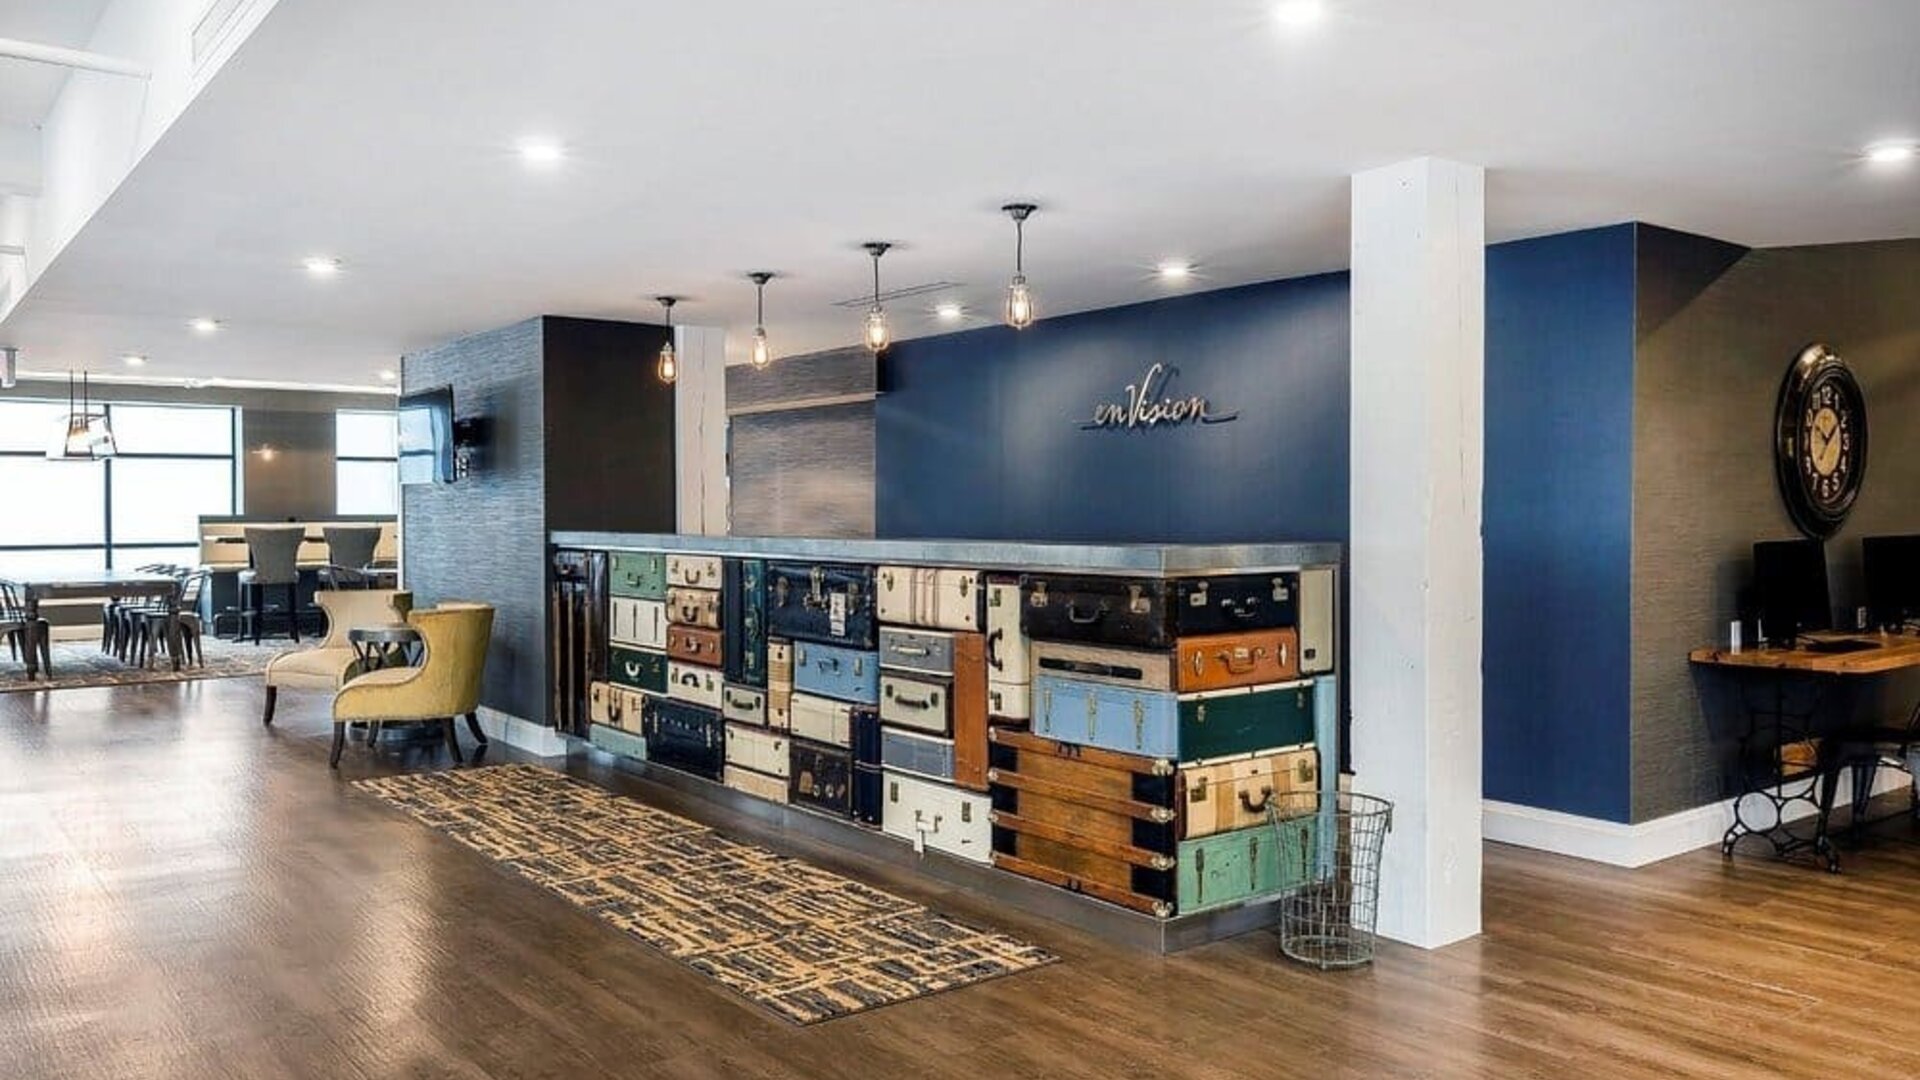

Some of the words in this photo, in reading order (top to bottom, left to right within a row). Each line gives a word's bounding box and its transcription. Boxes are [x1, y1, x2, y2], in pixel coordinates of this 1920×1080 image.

[1078, 362, 1239, 428] enVision
[1821, 385, 1832, 405] 12
[1840, 410, 1847, 428] 2
[1842, 433, 1849, 451] 3
[1840, 455, 1847, 473] 4
[1812, 472, 1819, 490] 7
[1822, 479, 1829, 497] 6
[1832, 472, 1840, 491] 5
